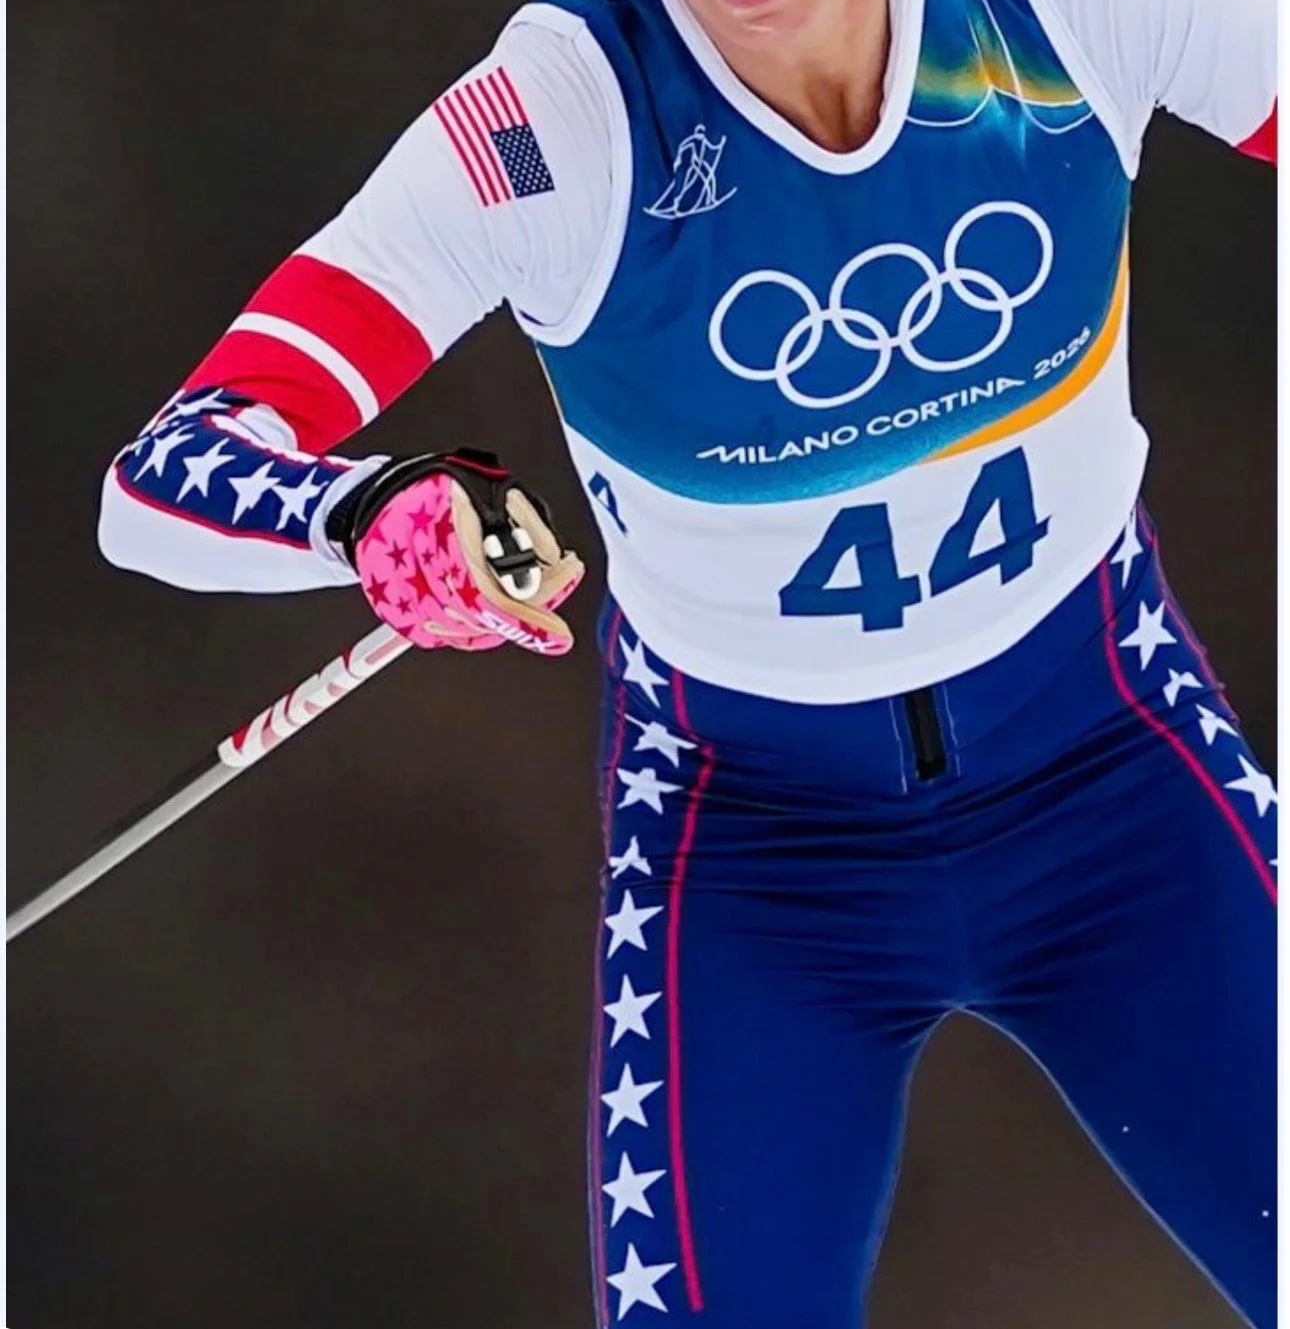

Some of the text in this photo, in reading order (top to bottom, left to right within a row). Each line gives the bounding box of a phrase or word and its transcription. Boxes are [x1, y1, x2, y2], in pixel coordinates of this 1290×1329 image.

[696, 325, 1092, 464] MILANO CORTINA 2026
[778, 445, 1053, 633] 44
